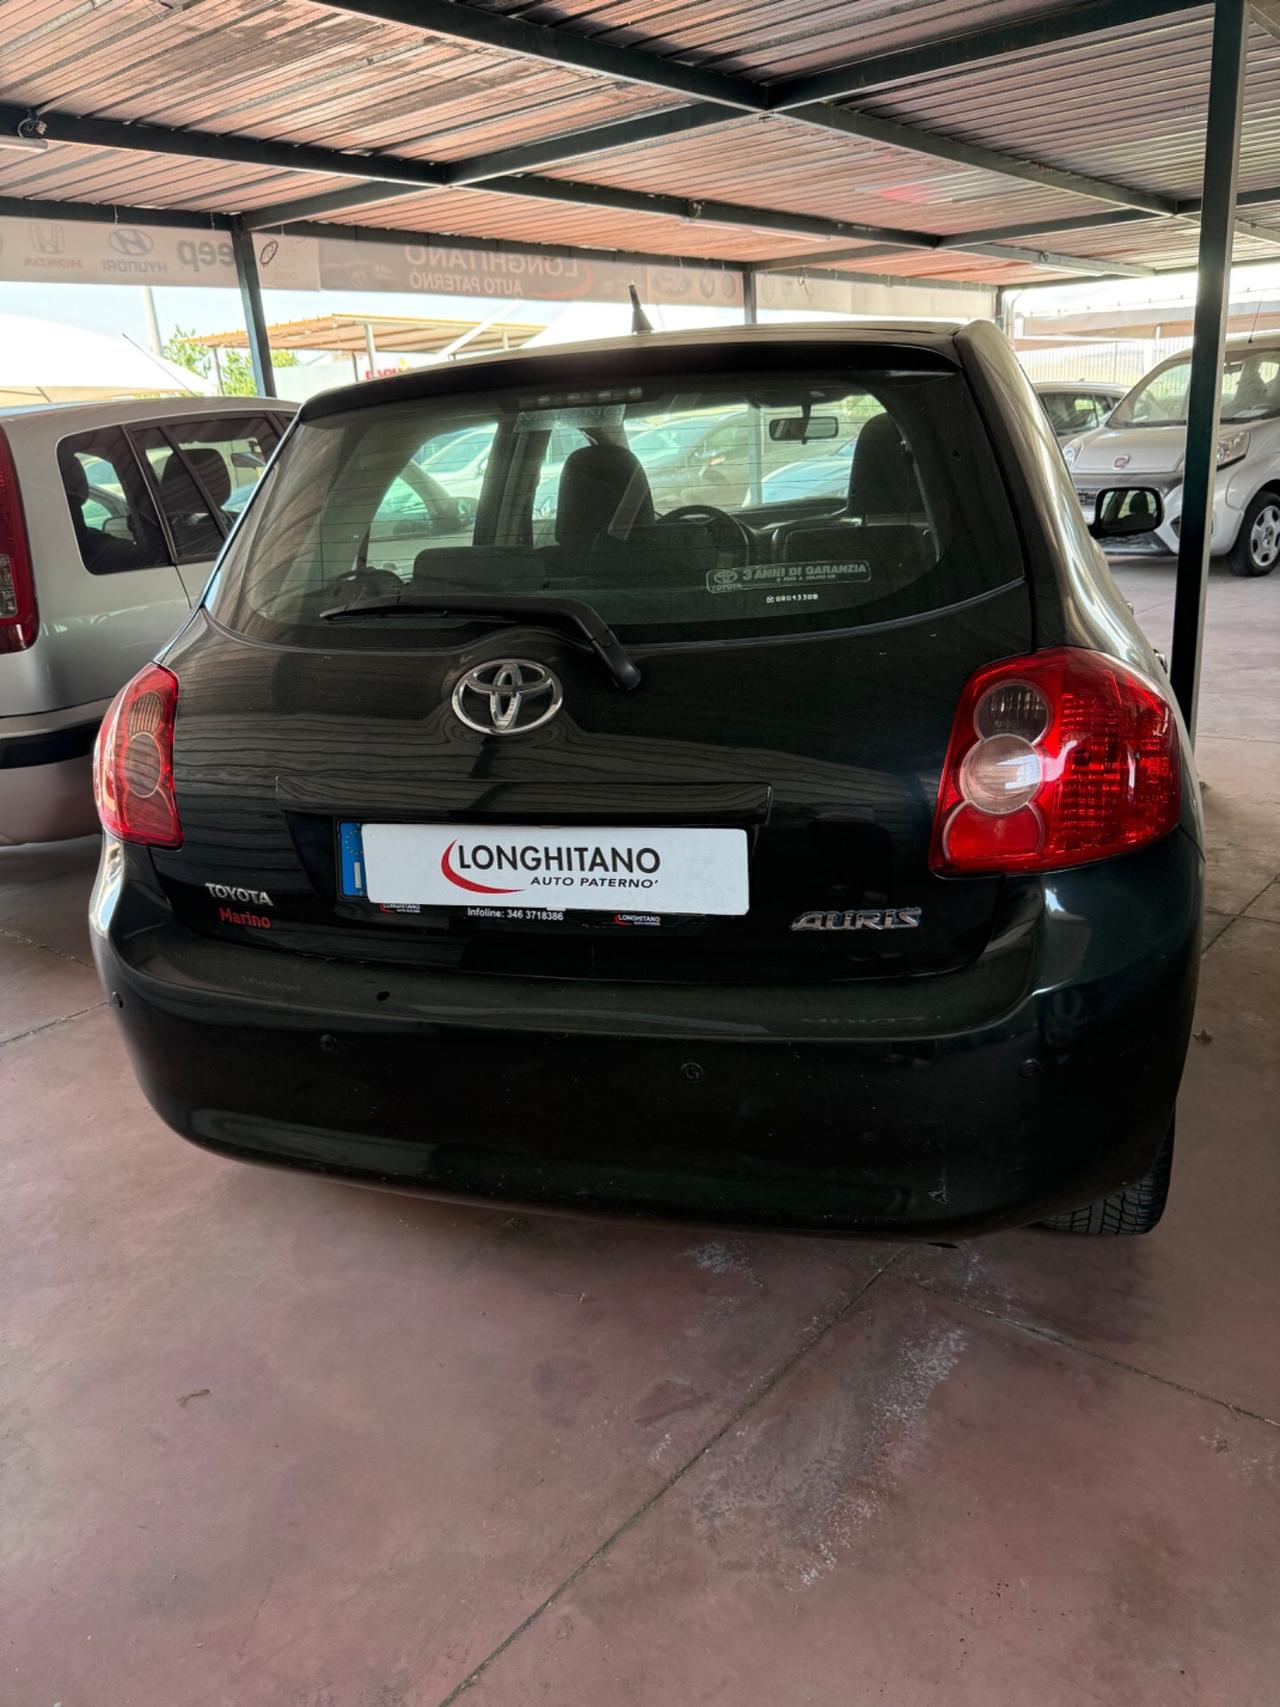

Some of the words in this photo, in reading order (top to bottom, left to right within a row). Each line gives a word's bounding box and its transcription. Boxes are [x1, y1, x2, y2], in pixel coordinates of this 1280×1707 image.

[742, 569, 753, 581] 3
[753, 566, 785, 580] ANNI
[788, 566, 802, 577] DI
[805, 563, 867, 576] GARANZIA
[458, 844, 661, 874] LONGHITANO
[530, 876, 575, 887] AUTO
[205, 882, 274, 906] TOYOTA
[219, 906, 272, 929] Marino
[467, 907, 505, 918] Infoline:
[506, 909, 524, 919] 346
[525, 910, 564, 921] 3718386
[791, 907, 922, 931] AURIS
